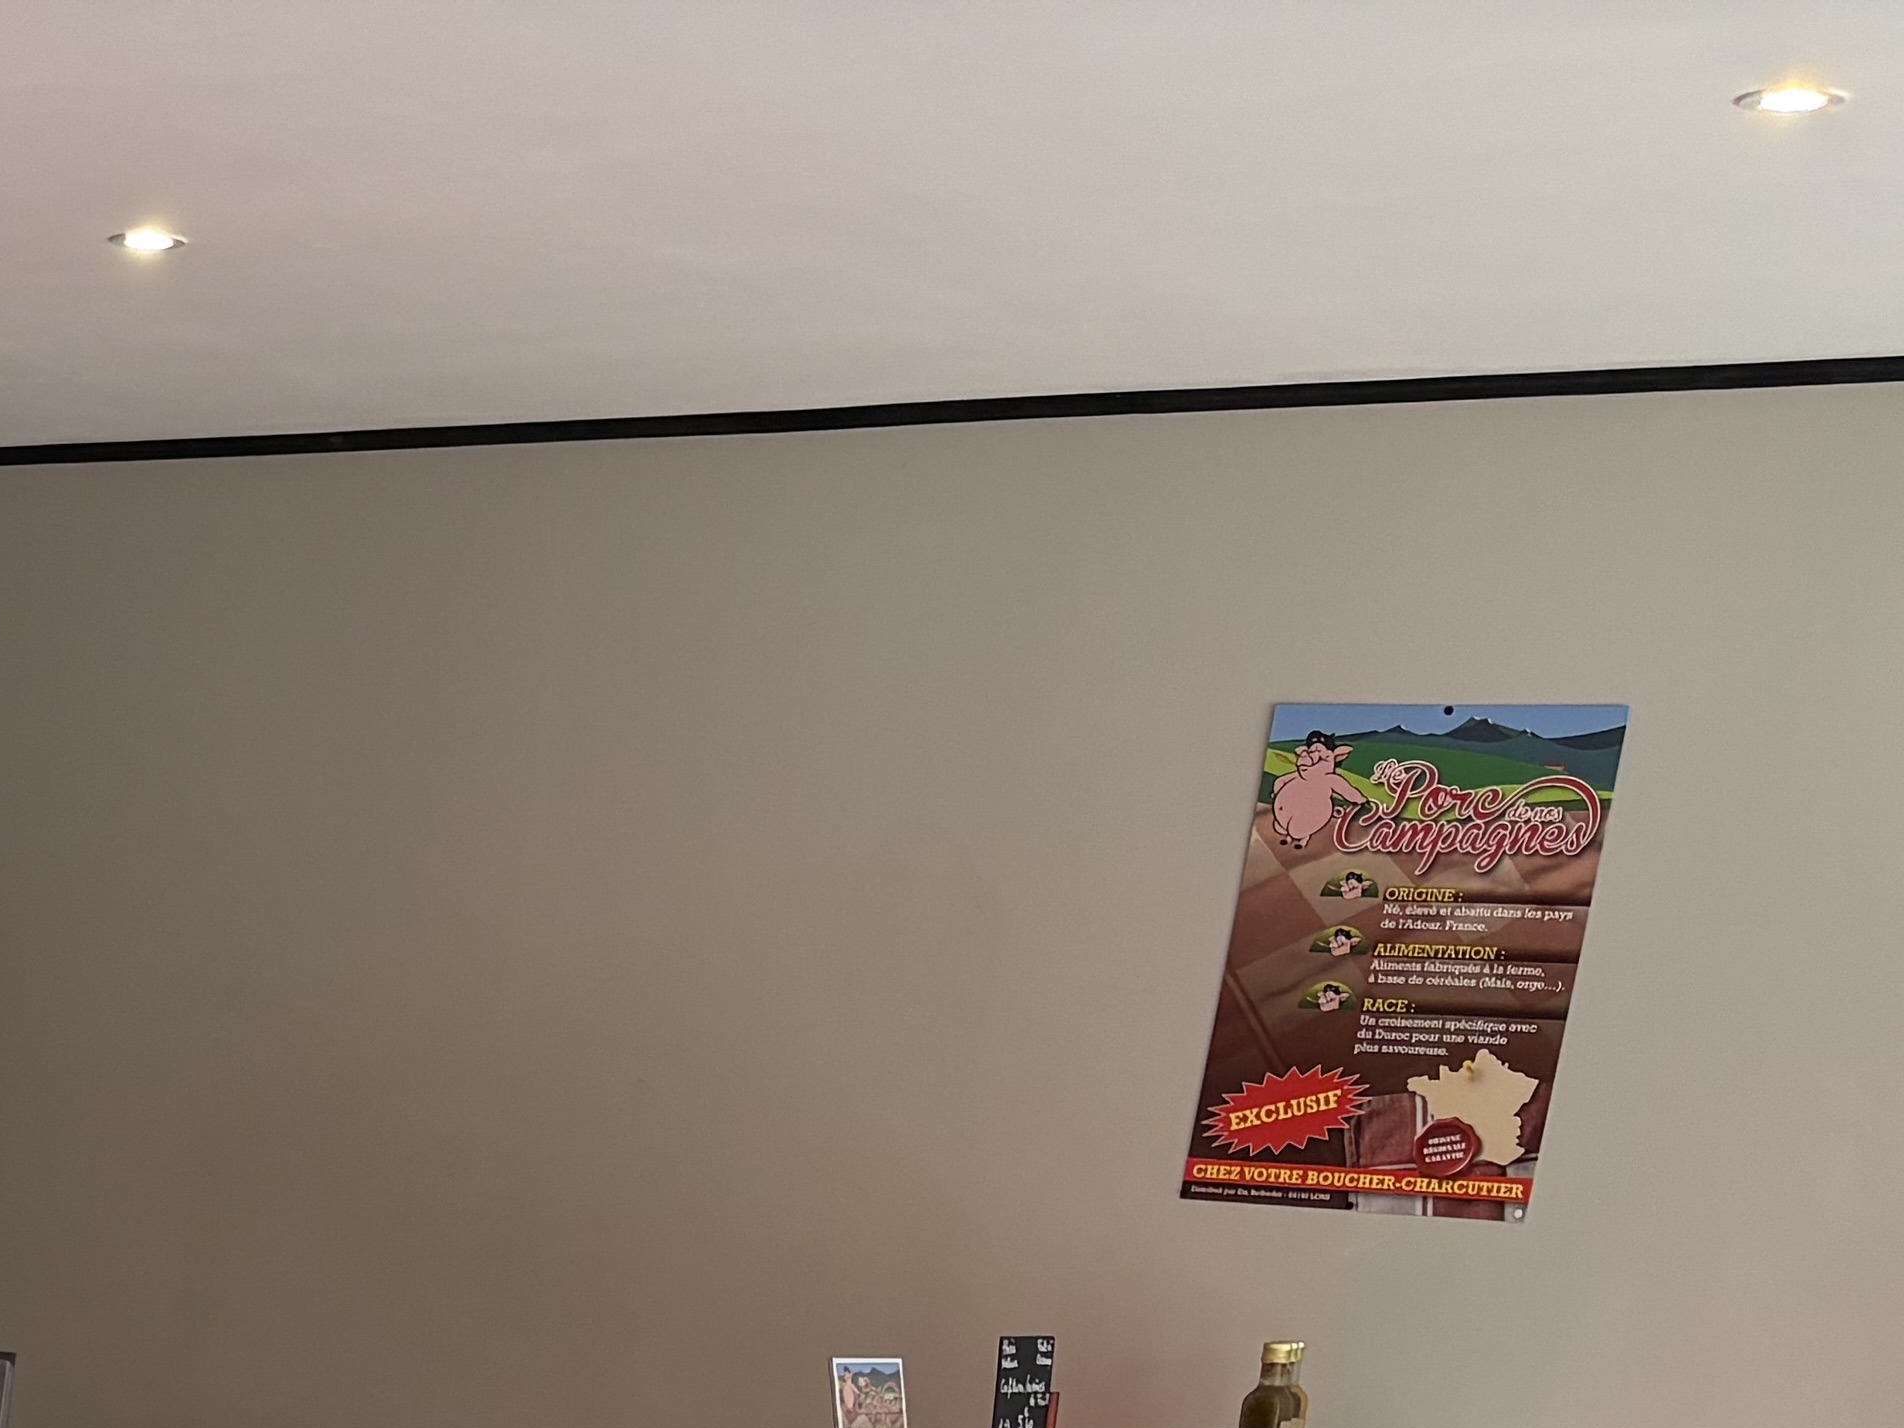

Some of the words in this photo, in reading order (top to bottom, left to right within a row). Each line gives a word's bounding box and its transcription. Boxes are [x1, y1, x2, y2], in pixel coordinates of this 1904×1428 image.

[1333, 798, 1592, 875] Campagnes
[1385, 888, 1456, 902] ORIGINE
[1454, 906, 1492, 918] abattu
[1493, 907, 1522, 919] dans
[1373, 943, 1498, 960] ALIMENTATION
[1370, 961, 1422, 973] Aliments
[1423, 962, 1481, 977] fabriqués
[1378, 973, 1406, 985] base
[1425, 976, 1477, 988] céréales
[1362, 998, 1409, 1013] RACE
[1359, 1015, 1376, 1027] Un
[1378, 1016, 1443, 1029] croisement
[1374, 1029, 1410, 1042] Duroc
[1411, 1032, 1440, 1045] pour
[1229, 1089, 1343, 1132] EXCLUSIF
[1192, 1163, 1241, 1180] CHEZ
[1243, 1166, 1305, 1184] VOTRE
[1307, 1170, 1524, 1199] BOUCHER-CHARCUTIER
